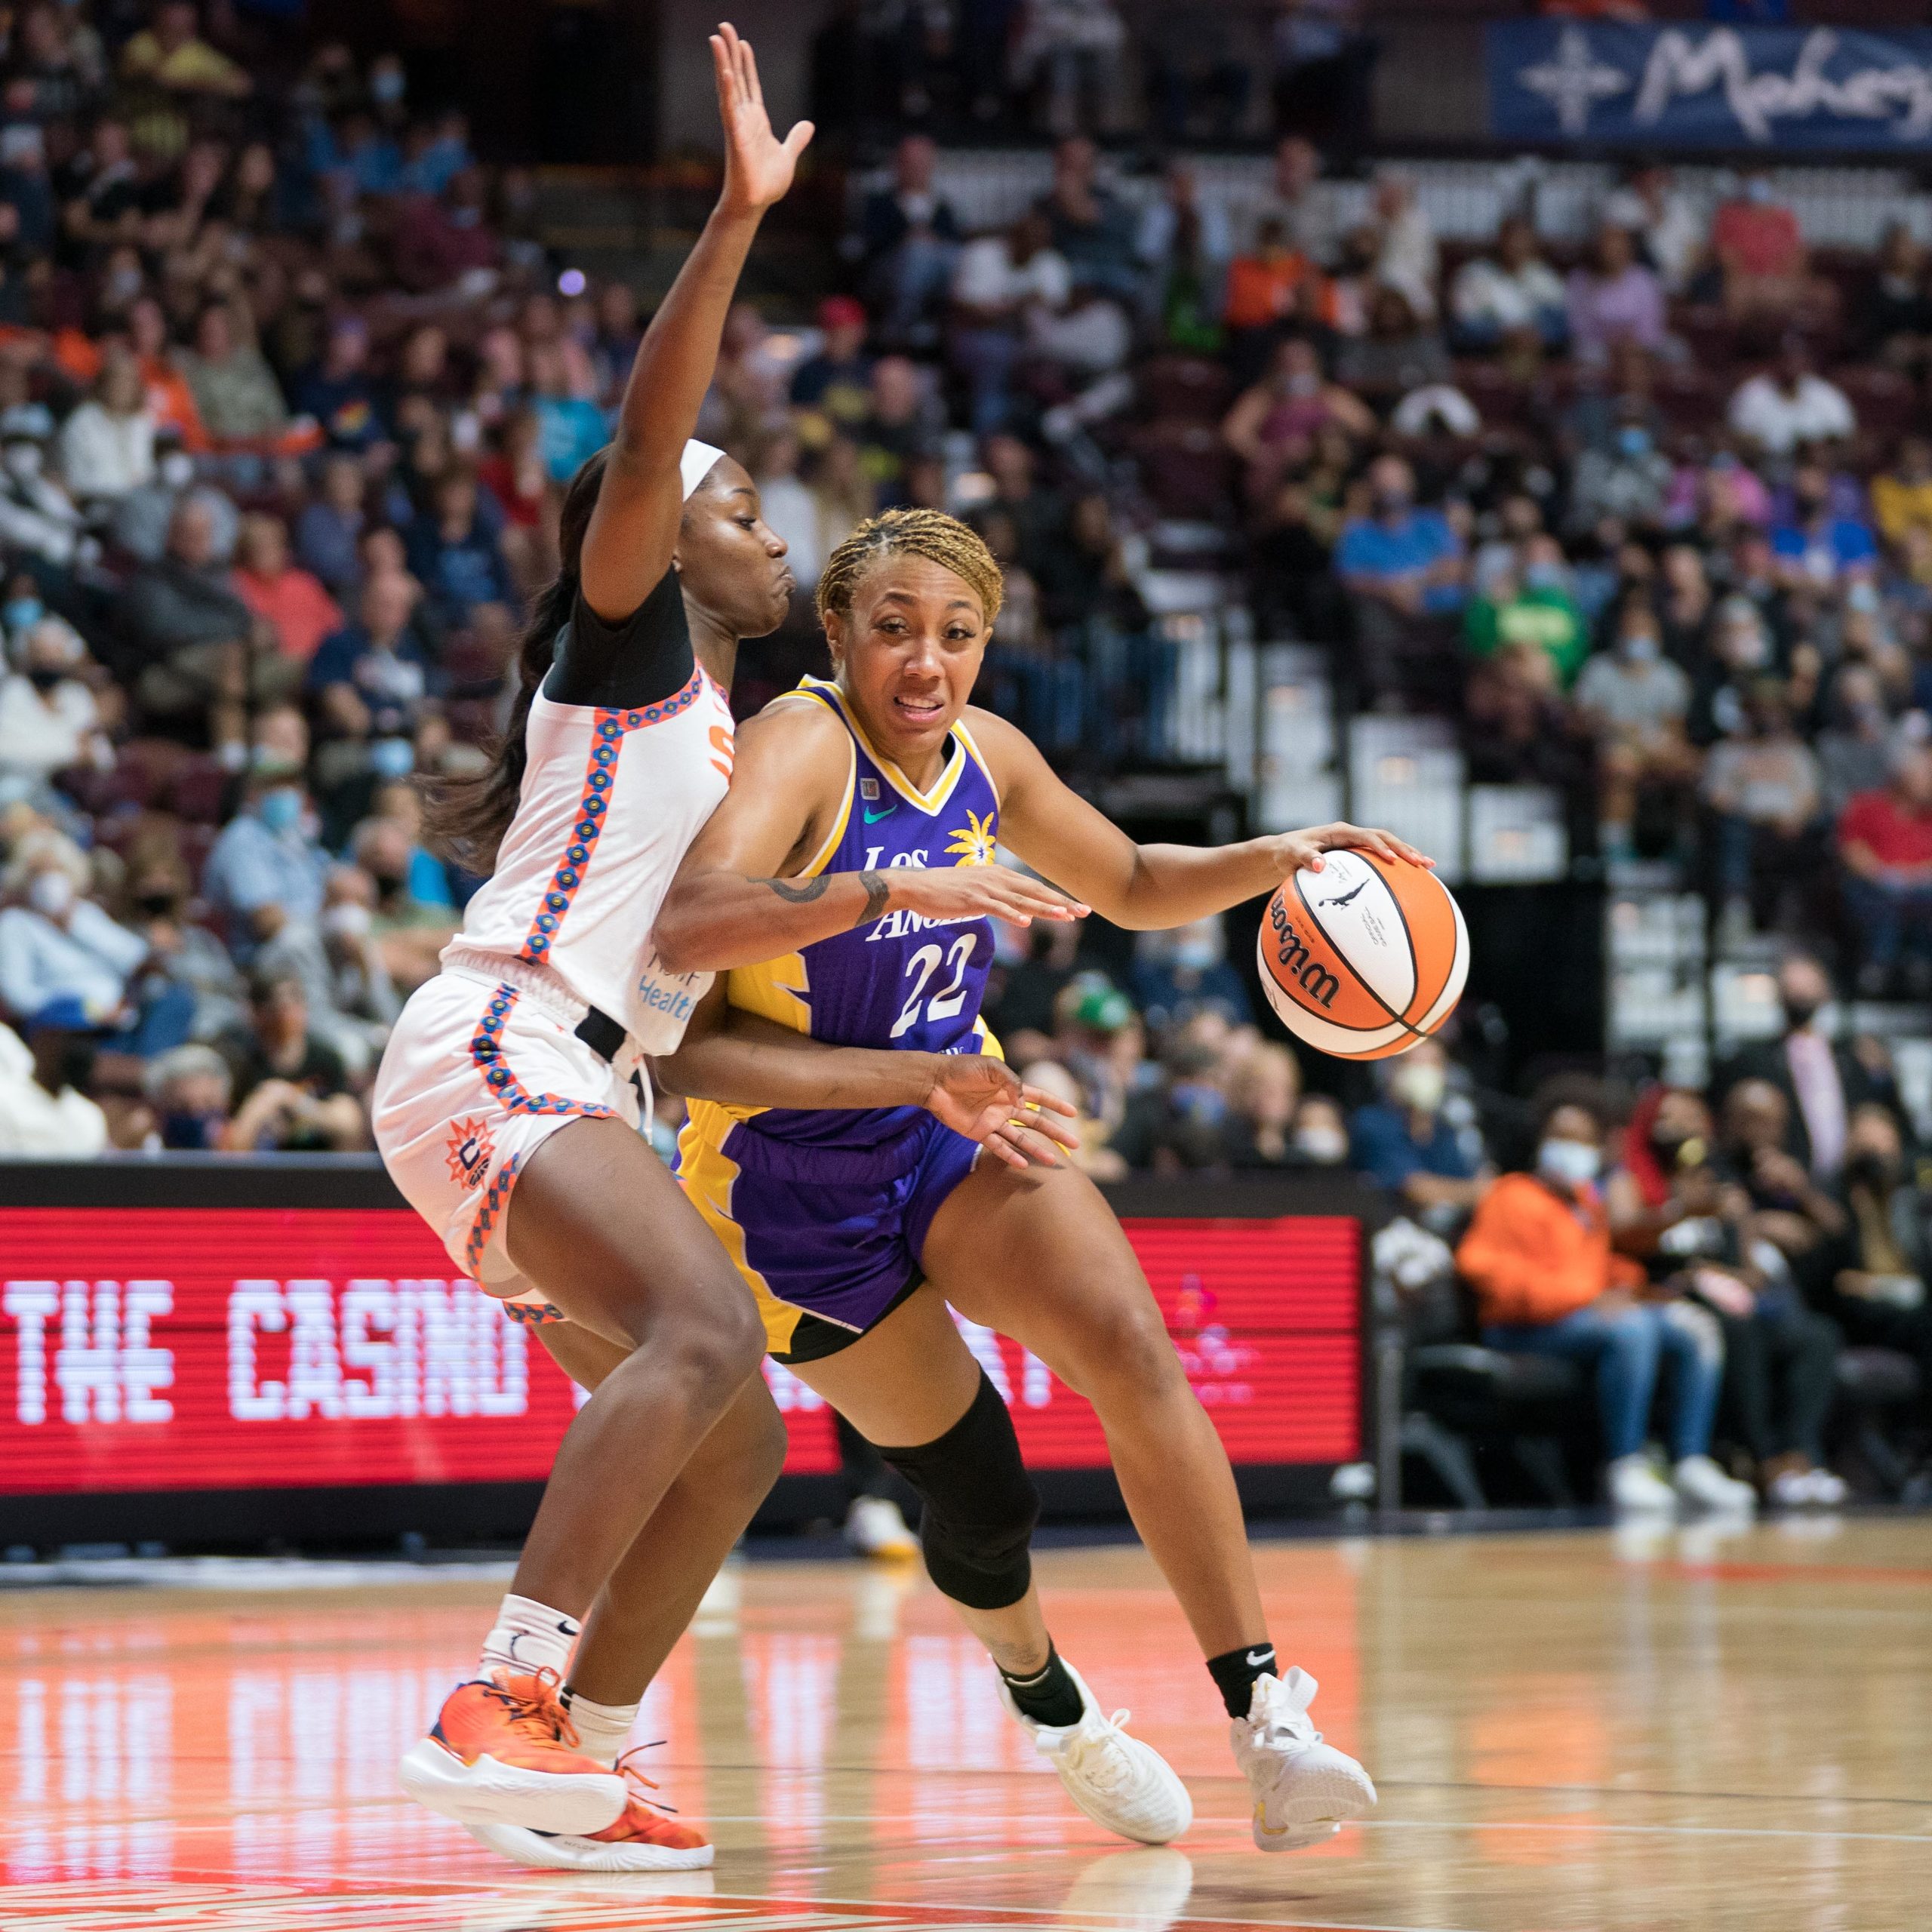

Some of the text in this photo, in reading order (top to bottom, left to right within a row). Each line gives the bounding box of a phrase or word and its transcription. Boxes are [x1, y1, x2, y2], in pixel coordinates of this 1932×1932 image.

[890, 934, 977, 1038] 22
[1271, 889, 1340, 1010] Wilson
[4, 1280, 174, 1424] THE
[228, 1278, 529, 1420] CASINO
